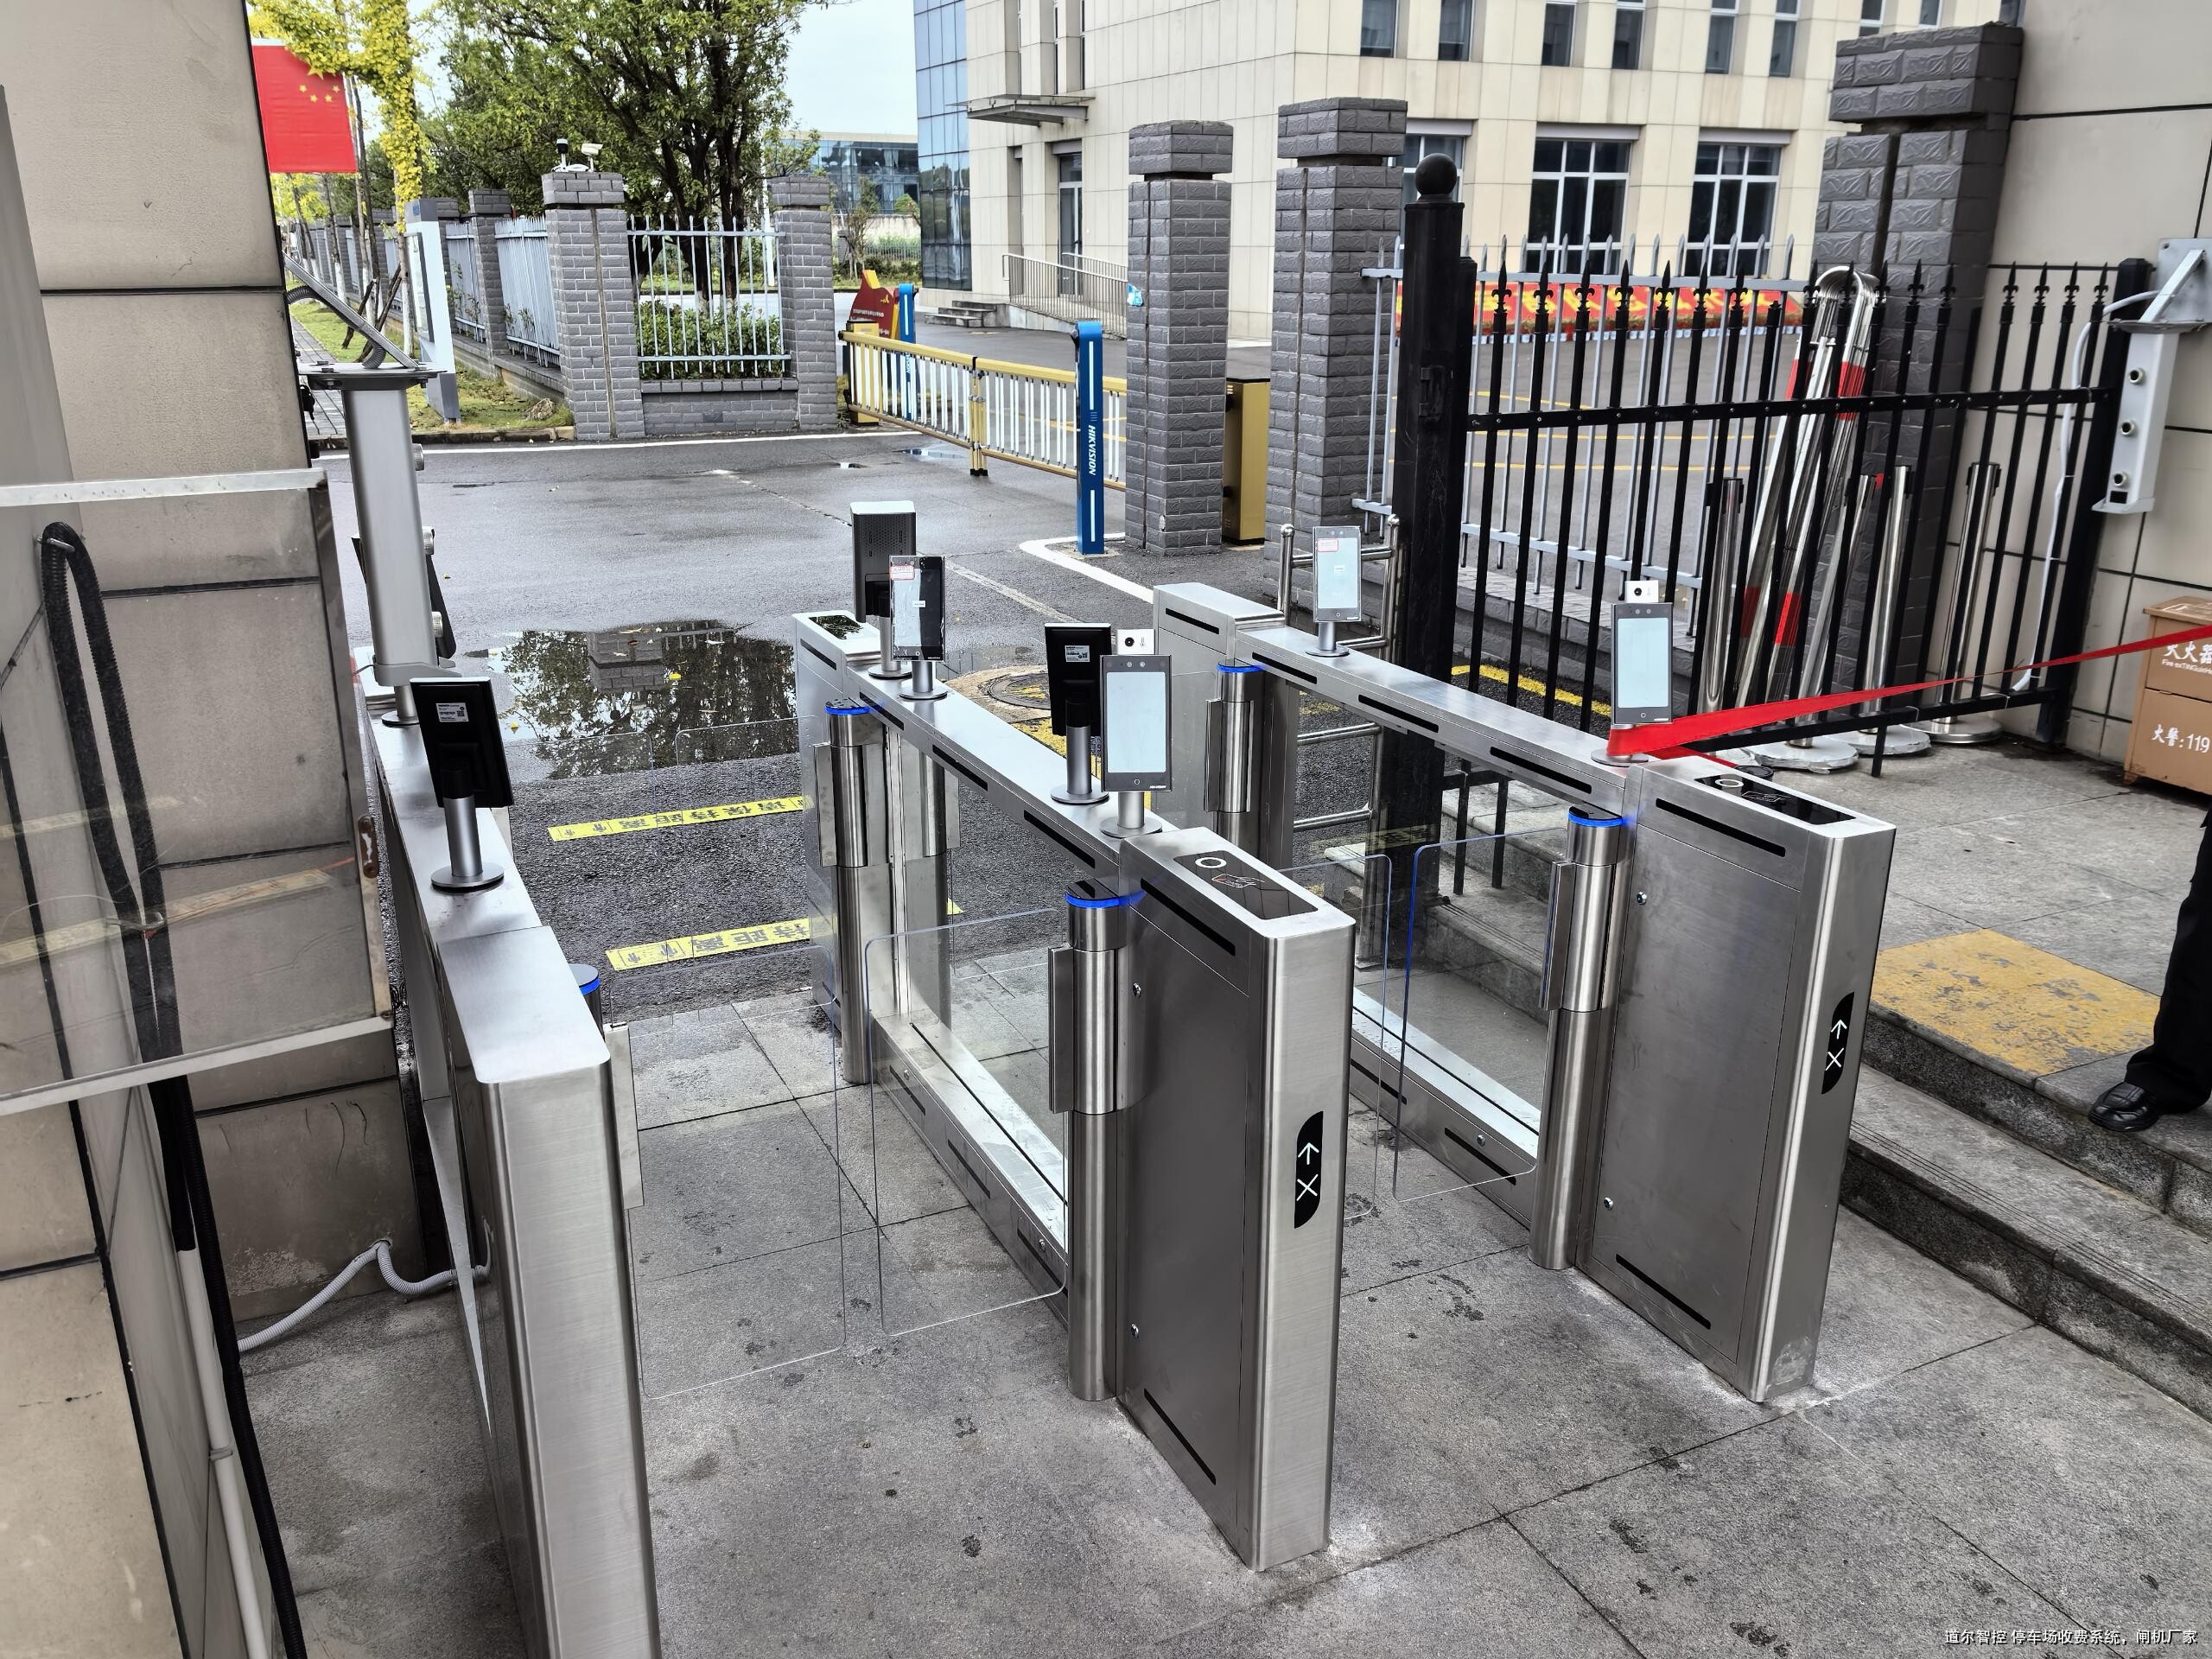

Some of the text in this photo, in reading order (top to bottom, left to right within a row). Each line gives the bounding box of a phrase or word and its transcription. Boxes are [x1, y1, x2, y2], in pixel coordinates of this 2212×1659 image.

[2151, 724, 2210, 753] 火警:119
[618, 801, 785, 830] 请保持距离
